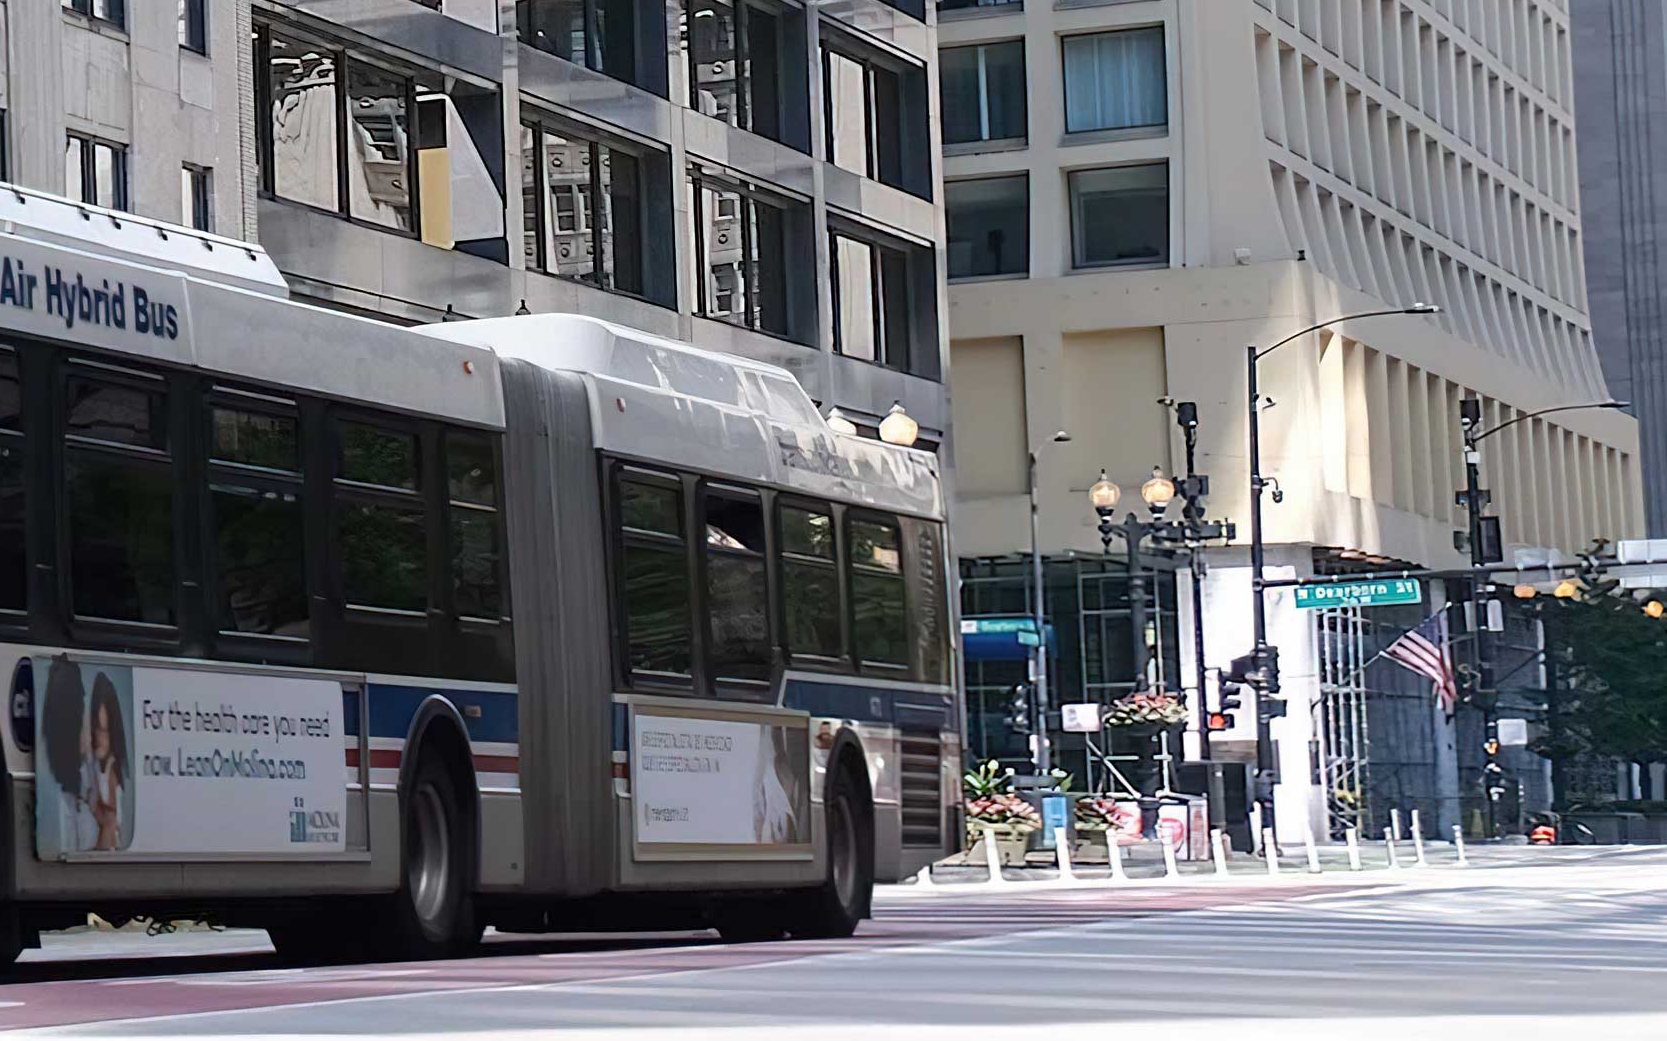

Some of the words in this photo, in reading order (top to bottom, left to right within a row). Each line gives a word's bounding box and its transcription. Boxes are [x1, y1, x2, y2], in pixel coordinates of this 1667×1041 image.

[0, 256, 38, 310] Air
[44, 265, 126, 329] Hybrid
[133, 285, 179, 340] Bus
[143, 699, 165, 731] For
[169, 701, 192, 731] the
[195, 701, 238, 734] health
[242, 714, 270, 736] care
[273, 715, 297, 743] you
[300, 711, 331, 738] need
